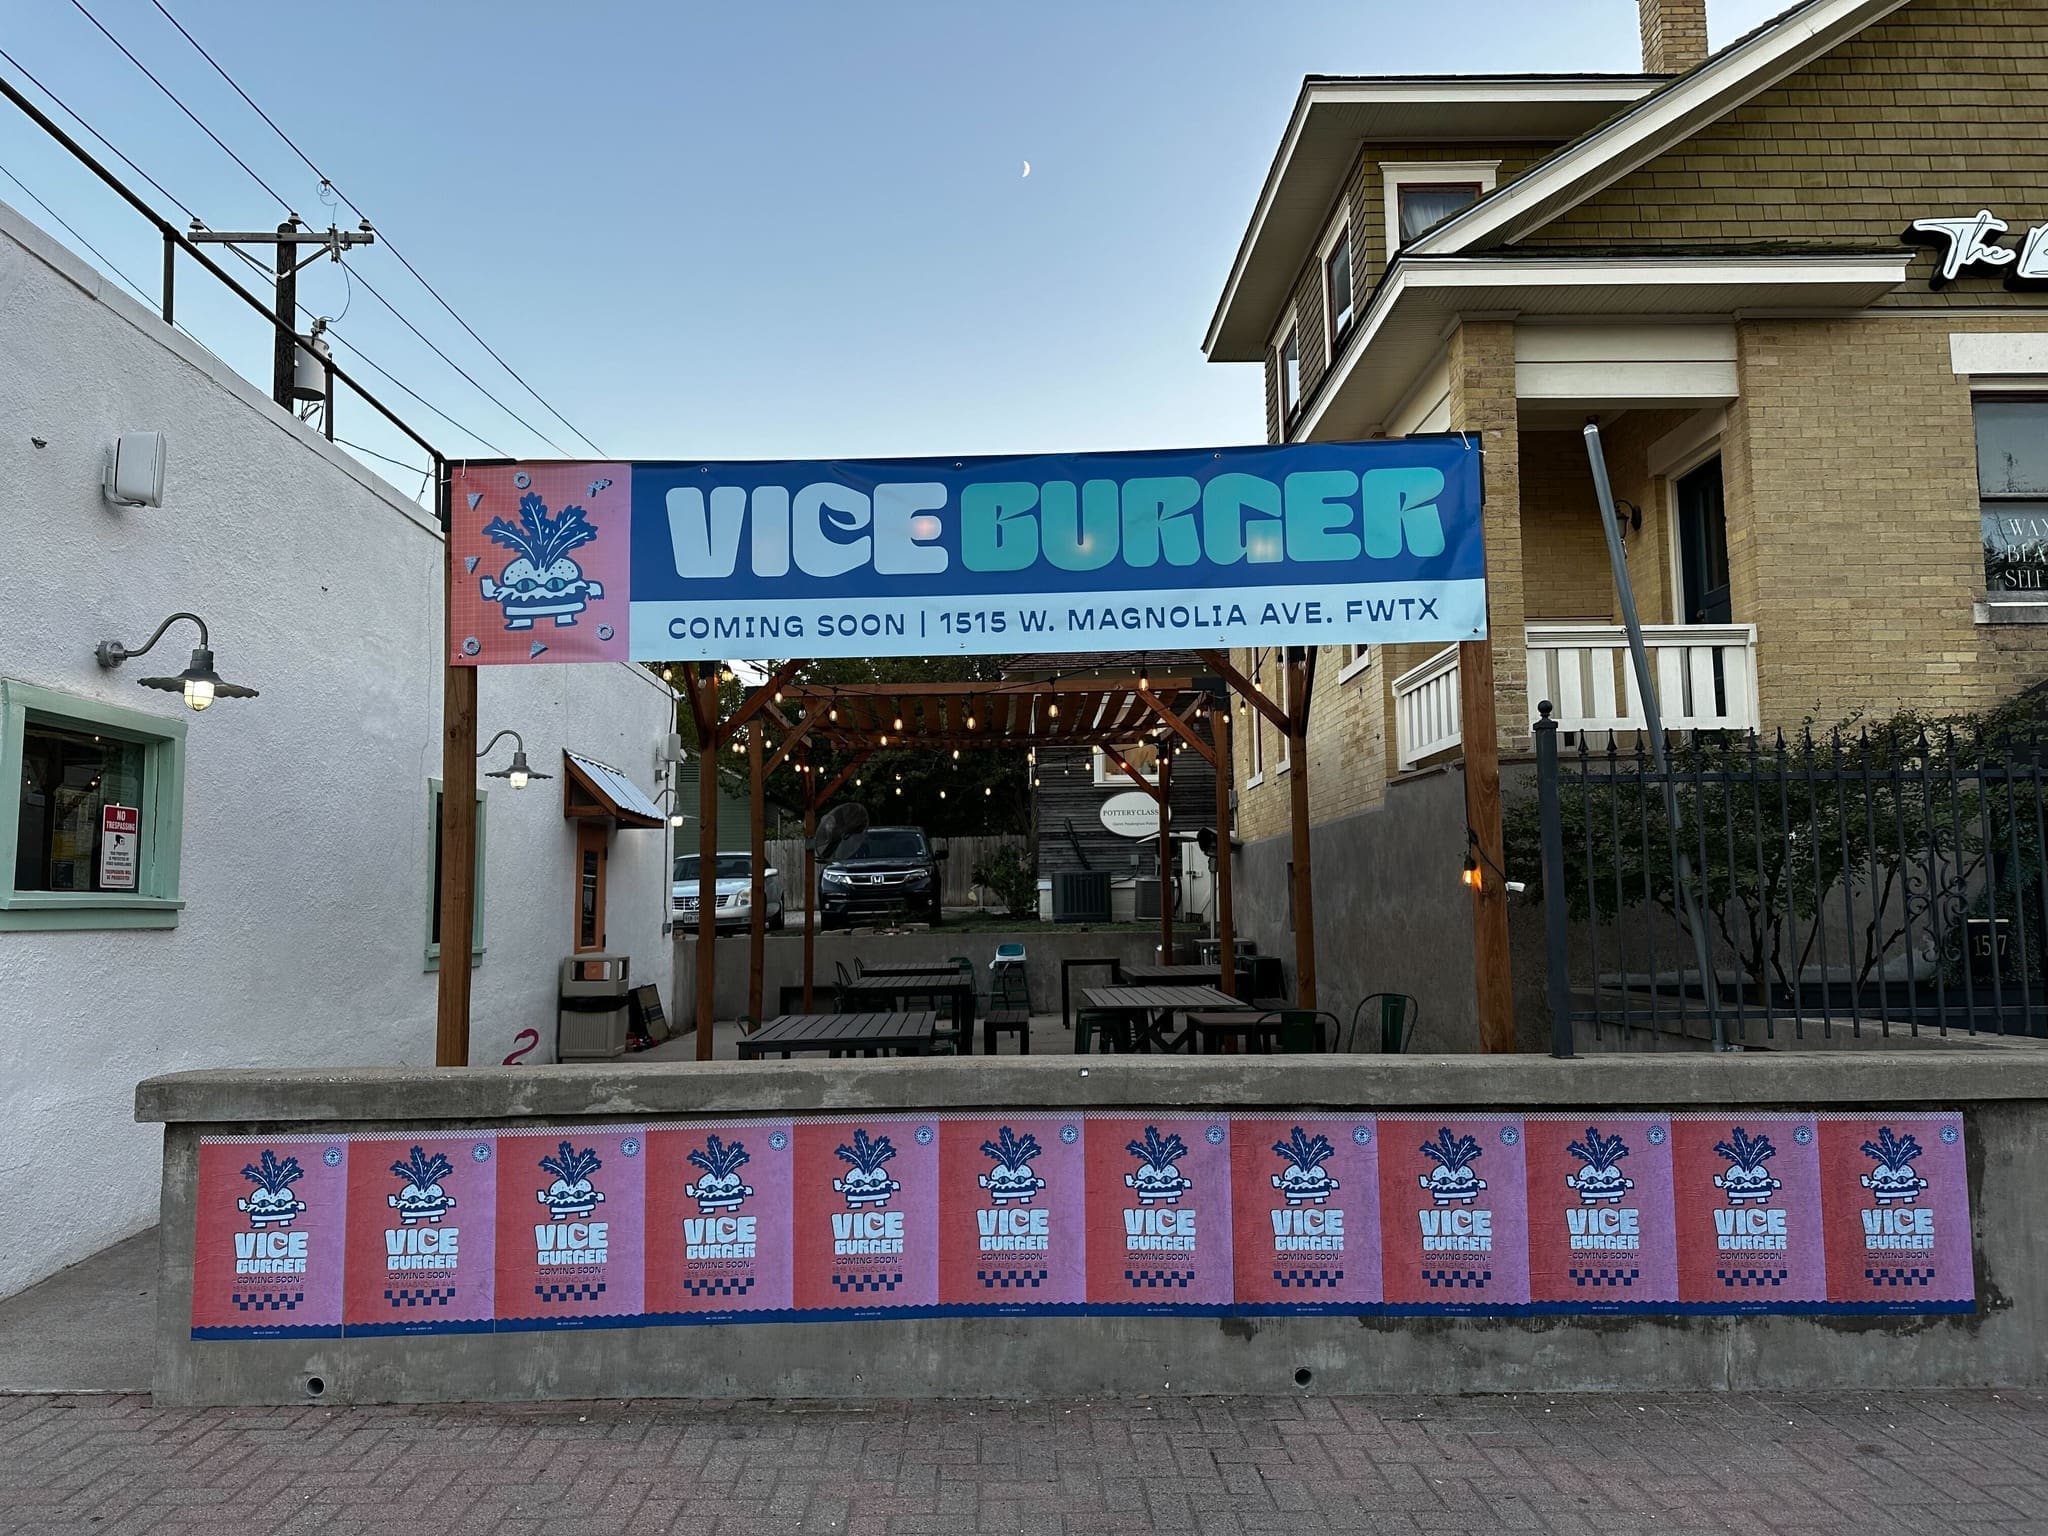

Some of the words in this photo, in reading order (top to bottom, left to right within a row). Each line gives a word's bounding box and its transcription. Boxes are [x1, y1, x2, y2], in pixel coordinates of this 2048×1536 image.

[1912, 208, 2017, 280] The
[664, 481, 949, 578] VICE
[960, 466, 1446, 573] BURGER
[2005, 569, 2045, 589] SELF
[668, 615, 805, 641] COMING
[817, 611, 906, 638] SOON
[939, 609, 1007, 636] 1515
[1019, 608, 1056, 633] W.
[1067, 603, 1248, 632] MAGNOLIA
[1260, 601, 1333, 627] AVE.
[1345, 597, 1440, 623] FWTX
[116, 809, 126, 821] NO
[1136, 808, 1159, 816] CLASS
[106, 820, 135, 831] TRESPASSING
[1973, 934, 2007, 956] 157
[683, 1216, 757, 1244] VICE
[831, 1212, 904, 1239] VICE
[976, 1208, 1049, 1236] VICE
[1123, 1209, 1196, 1236] VICE
[1270, 1209, 1344, 1236] VICE
[1418, 1209, 1492, 1236] VICE
[1566, 1208, 1640, 1235] VICE
[1714, 1208, 1787, 1235] VICE
[1861, 1208, 1935, 1235] VICE
[234, 1231, 309, 1259] VICE
[384, 1227, 459, 1255] VICE
[535, 1223, 608, 1250] VICE
[979, 1236, 1049, 1251] BURGER
[1126, 1236, 1195, 1251] BURGER
[1274, 1236, 1344, 1251] BURGER
[1422, 1236, 1492, 1251] BURGER
[1570, 1235, 1639, 1250] BURGER
[1717, 1235, 1787, 1250] BURGER
[1865, 1235, 1935, 1250] BURGER
[536, 1250, 607, 1265] BURGER
[685, 1244, 755, 1259] BURGER
[834, 1240, 903, 1255] BURGER
[236, 1259, 306, 1274] BURGER
[386, 1255, 457, 1270] BURGER
